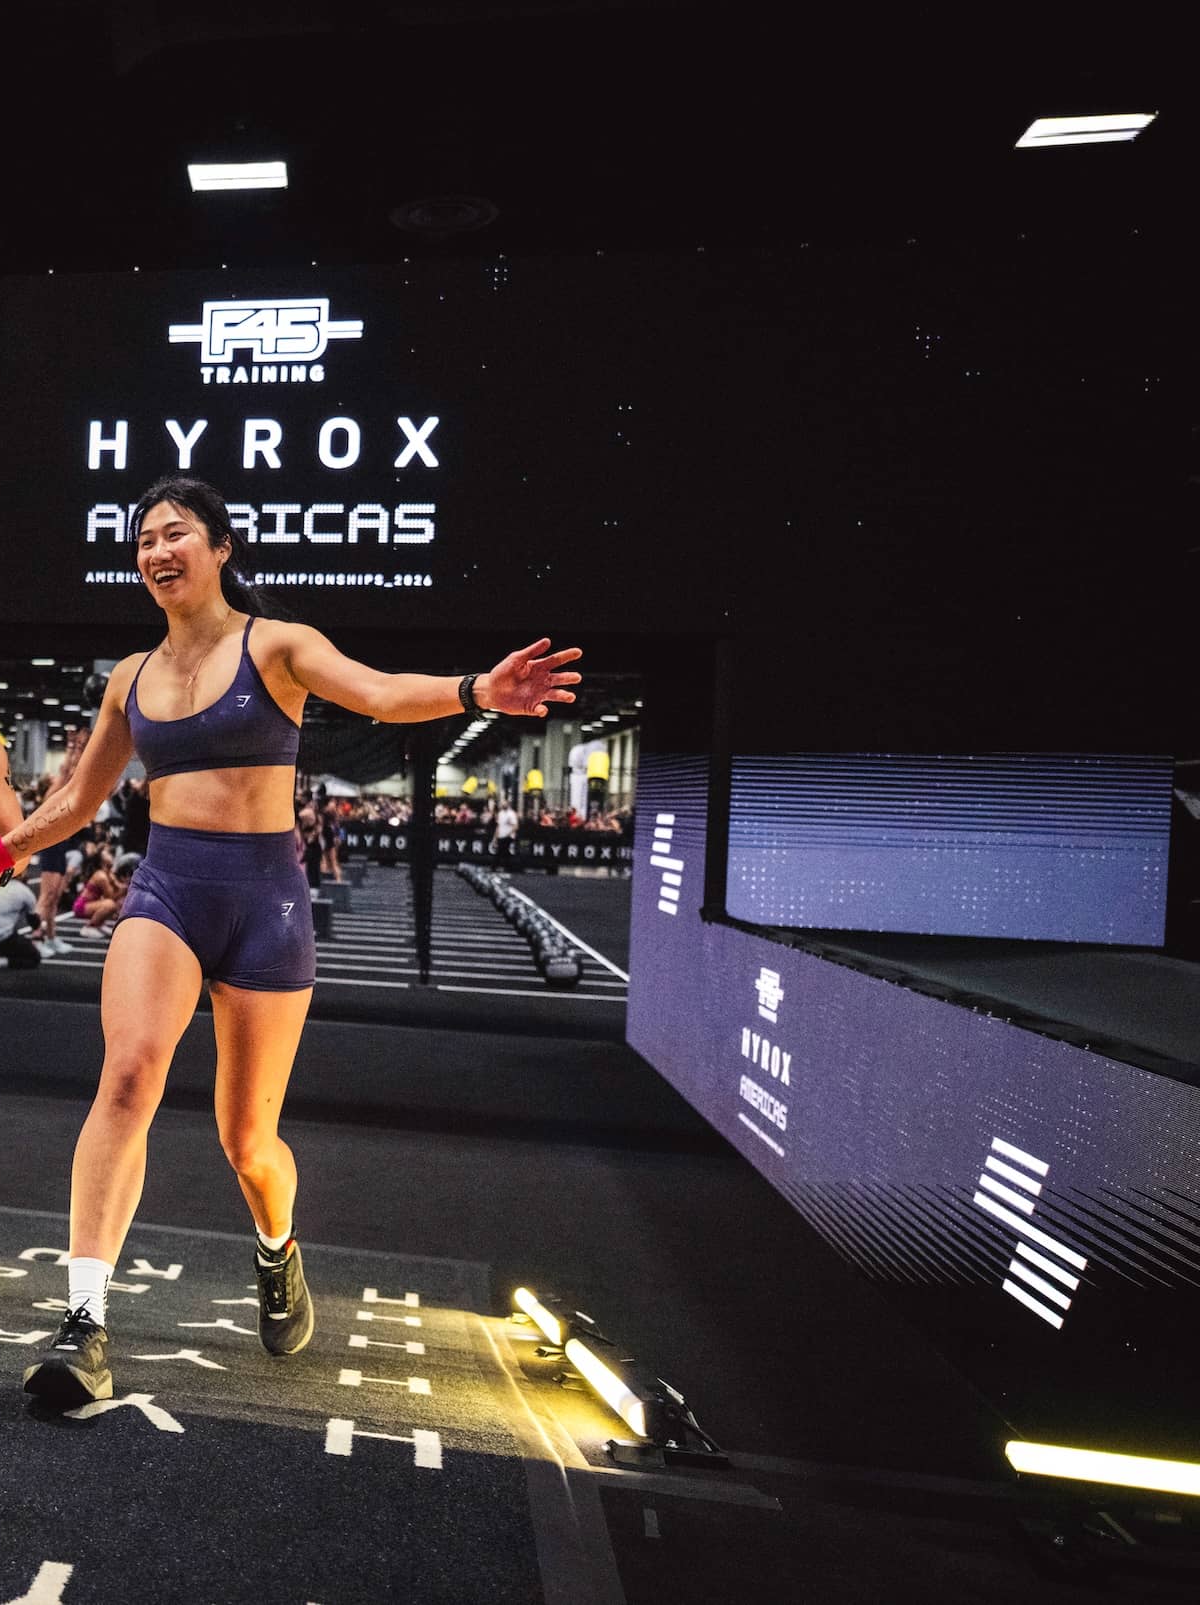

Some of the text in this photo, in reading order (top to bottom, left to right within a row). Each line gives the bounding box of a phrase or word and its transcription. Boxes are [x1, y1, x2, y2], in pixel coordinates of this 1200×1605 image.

[201, 298, 330, 363] F45
[200, 364, 325, 384] TRAINING
[87, 416, 440, 469] HYROX
[86, 503, 436, 544] ARICAS
[347, 833, 407, 850] HYRO
[533, 844, 611, 859] HYROX
[741, 1027, 791, 1086] HYROX
